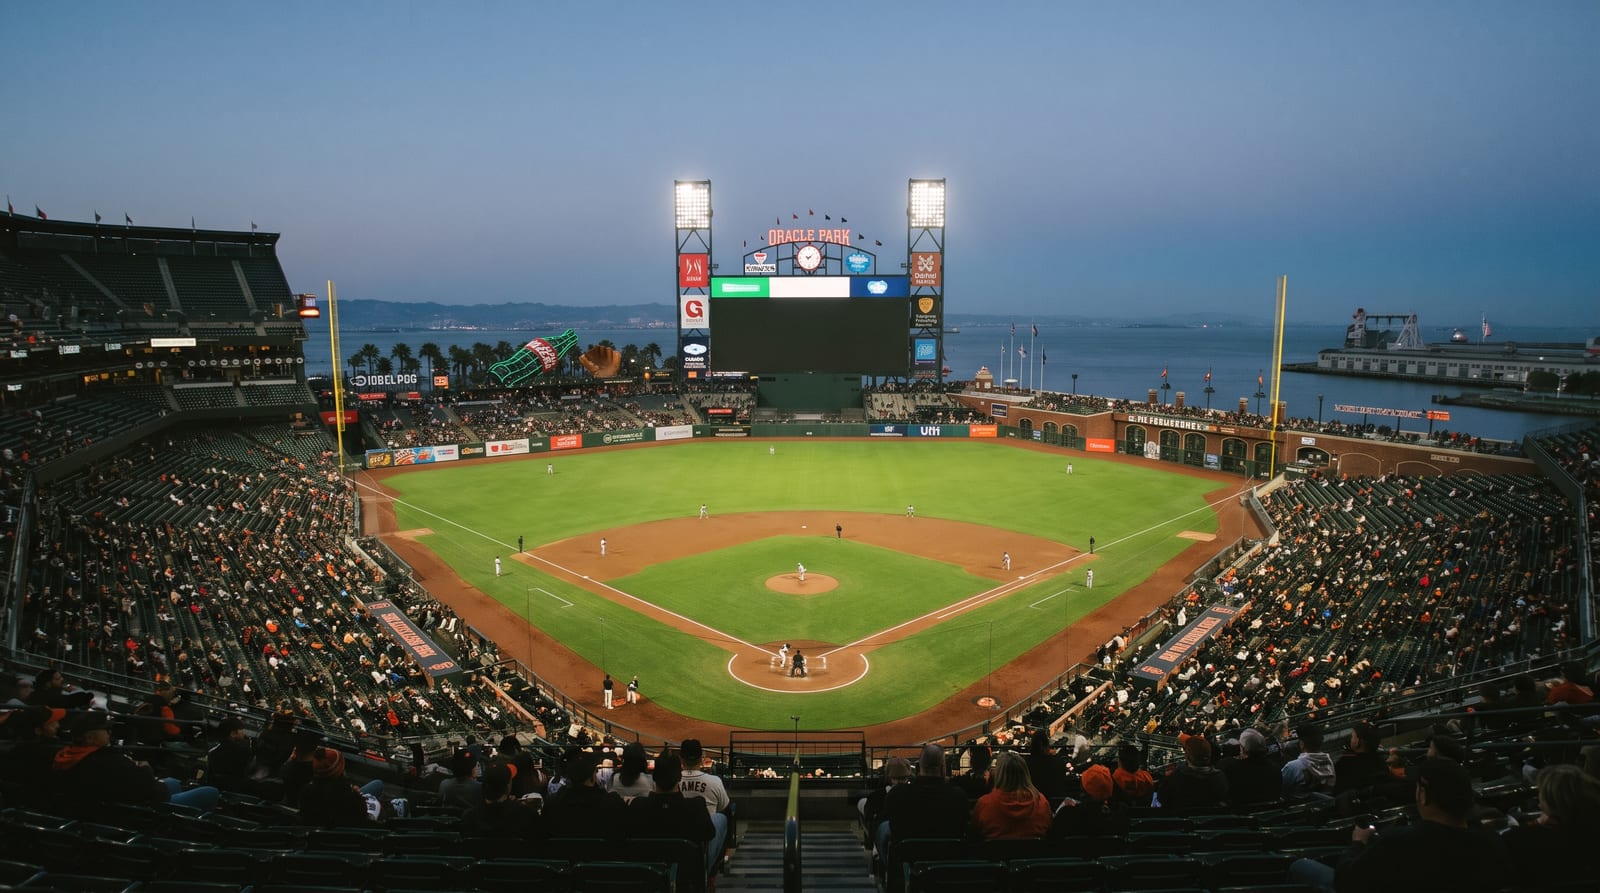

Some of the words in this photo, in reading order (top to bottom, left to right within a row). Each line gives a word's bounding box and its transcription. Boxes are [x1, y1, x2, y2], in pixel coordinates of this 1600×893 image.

[768, 229, 815, 245] ORACLE
[819, 229, 850, 246] PARK
[685, 300, 703, 318] G
[677, 780, 707, 793] AMES
